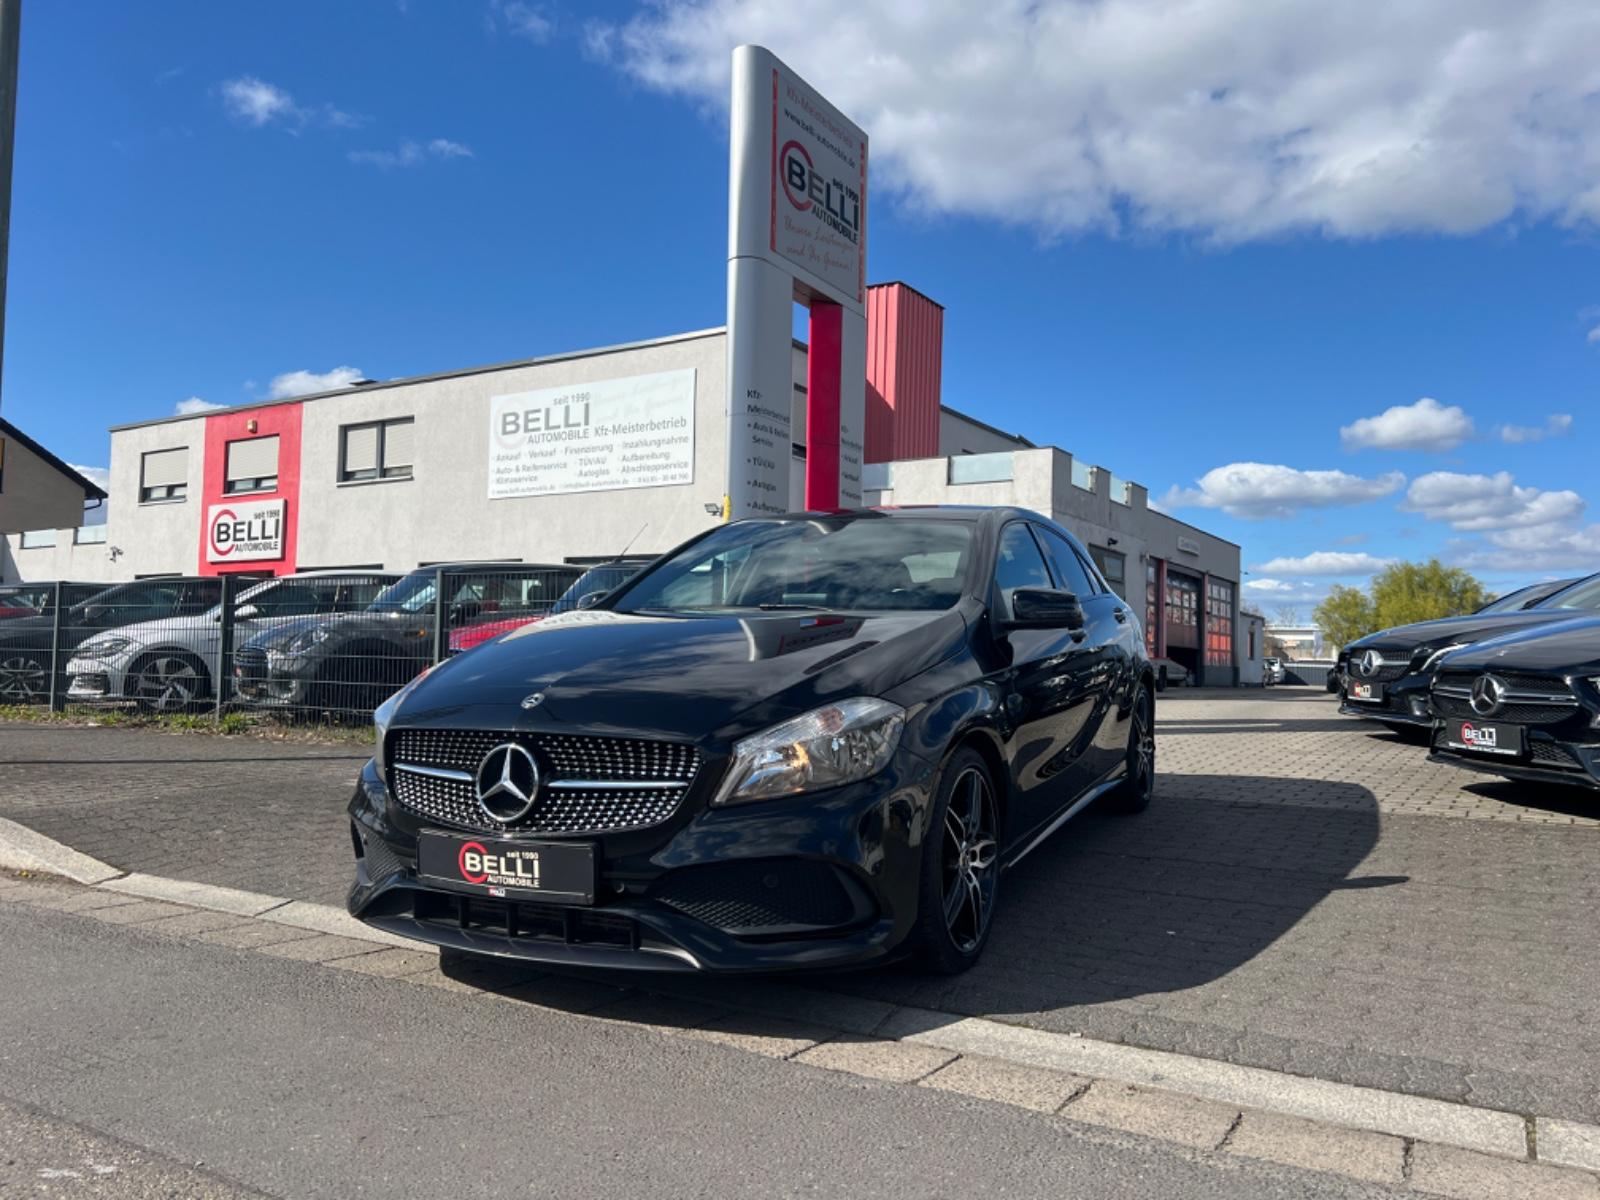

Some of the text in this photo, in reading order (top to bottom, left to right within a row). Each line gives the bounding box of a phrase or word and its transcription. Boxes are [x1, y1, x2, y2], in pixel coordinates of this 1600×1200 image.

[811, 204, 859, 246] AUTOMOBILE
[553, 392, 591, 406] seit 1990
[501, 402, 590, 436] BELLI
[594, 416, 687, 438] Kfz-Meisterbetrieb
[527, 428, 590, 445] AUTOMOBILE
[528, 448, 557, 458] Verkauf
[564, 444, 614, 456] Finanzierung
[216, 518, 280, 544] BELLI
[235, 541, 279, 552] AUTOMOBILE
[464, 851, 540, 879] BELLI
[487, 875, 540, 888] AUTOMOBILE
